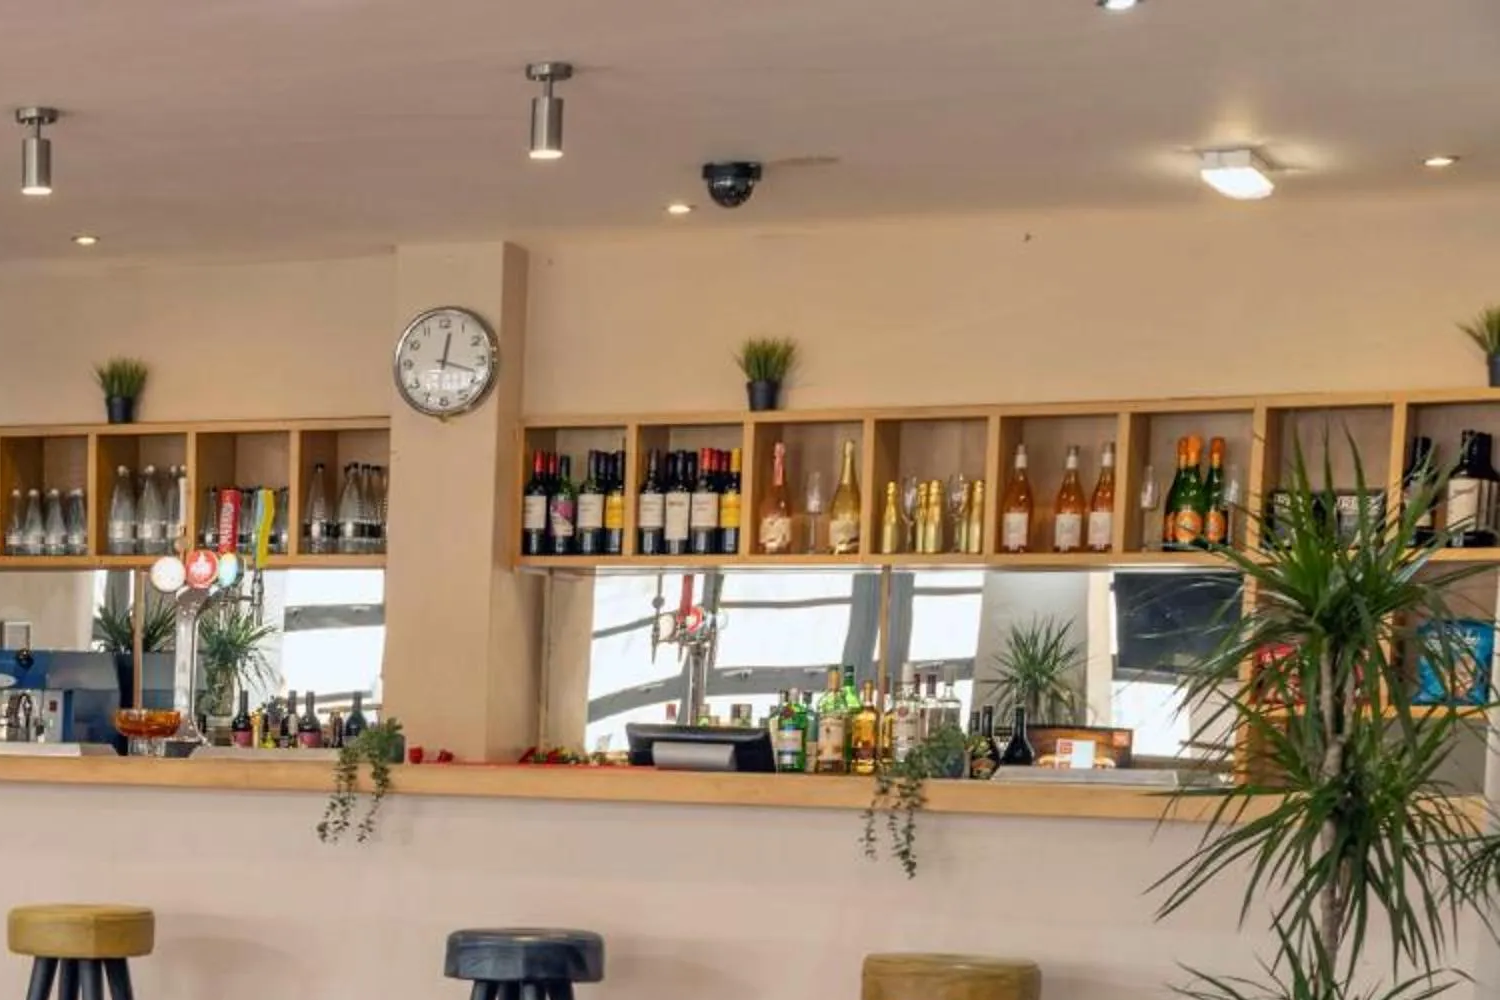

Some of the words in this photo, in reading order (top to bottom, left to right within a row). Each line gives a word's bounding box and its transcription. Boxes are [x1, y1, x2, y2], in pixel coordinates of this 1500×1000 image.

[439, 319, 452, 329] 12
[423, 326, 431, 337] 11
[470, 335, 482, 347] 2
[403, 359, 414, 371] 9
[474, 355, 487, 367] 3
